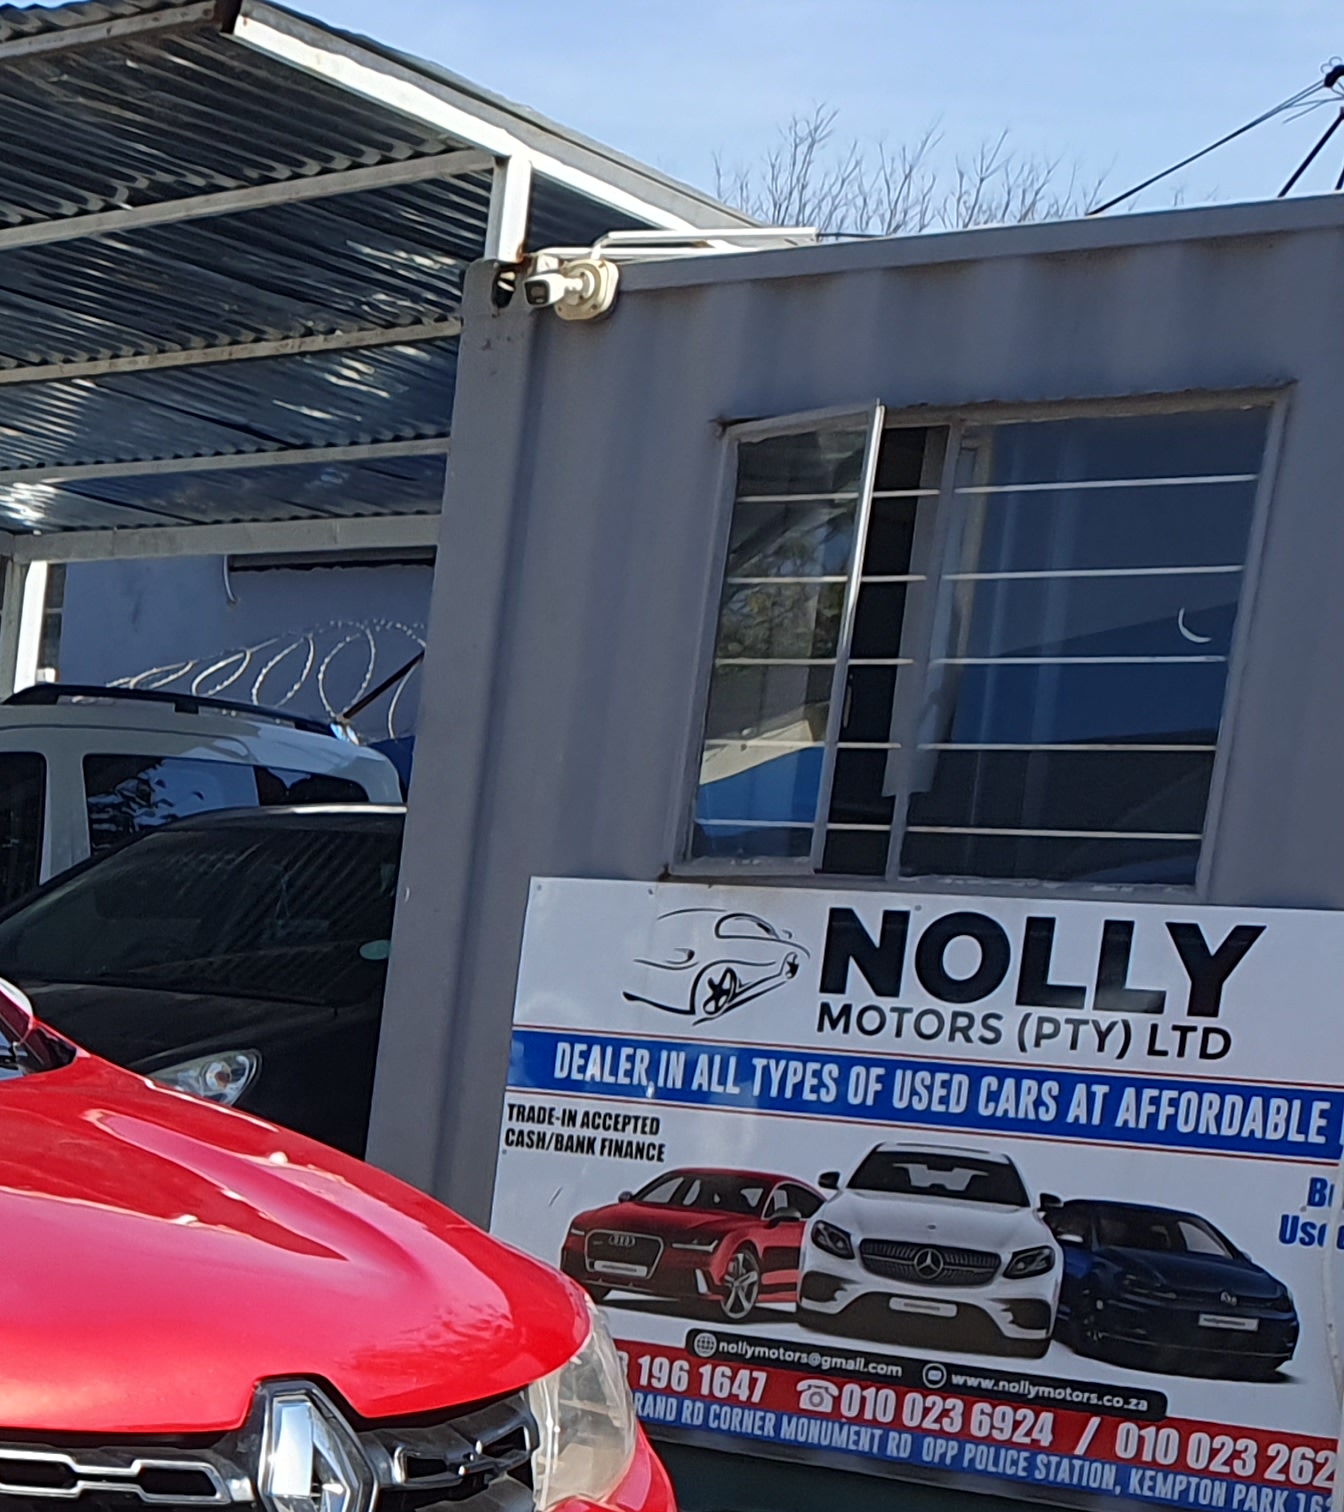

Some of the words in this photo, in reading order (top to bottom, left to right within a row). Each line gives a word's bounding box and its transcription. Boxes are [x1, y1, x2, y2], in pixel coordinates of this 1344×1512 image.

[819, 906, 1267, 1018] NOLLY
[816, 1001, 1004, 1046] MOTORS
[1017, 1011, 1132, 1060] (PTY)
[1147, 1022, 1232, 1060] LTD
[506, 1103, 577, 1129] TRADE-IN
[580, 1111, 660, 1136] ACCEPTED
[657, 1049, 686, 1090] IN
[691, 1053, 741, 1095] ALL
[752, 1057, 838, 1103] TYPES
[848, 1065, 886, 1107] OF
[893, 1068, 969, 1114] USED
[978, 1075, 1060, 1122] CARS
[1066, 1083, 1110, 1126] AT
[1114, 1086, 1331, 1144] AFFORDABLE
[504, 1128, 596, 1157] CASH/BANK
[599, 1140, 666, 1163] FINANCE
[718, 1341, 903, 1378] nollymotors@gmail.com
[637, 1354, 690, 1392] 196
[699, 1364, 768, 1404] 1647
[840, 1383, 897, 1424] 010
[902, 1391, 964, 1433] 023
[970, 1402, 1055, 1447] 6924
[1115, 1422, 1180, 1466] 010
[1186, 1432, 1258, 1478] 023
[951, 1371, 1148, 1412] www.nollymotors.co.za
[680, 1399, 704, 1427] RD
[710, 1404, 776, 1438] CORNER
[780, 1416, 882, 1454] MONUMENT
[886, 1432, 913, 1459] RD
[922, 1436, 960, 1466] OPP
[962, 1443, 1029, 1478] POLICE
[1034, 1455, 1122, 1496] STATION,
[1128, 1467, 1227, 1509] KEMPTON
